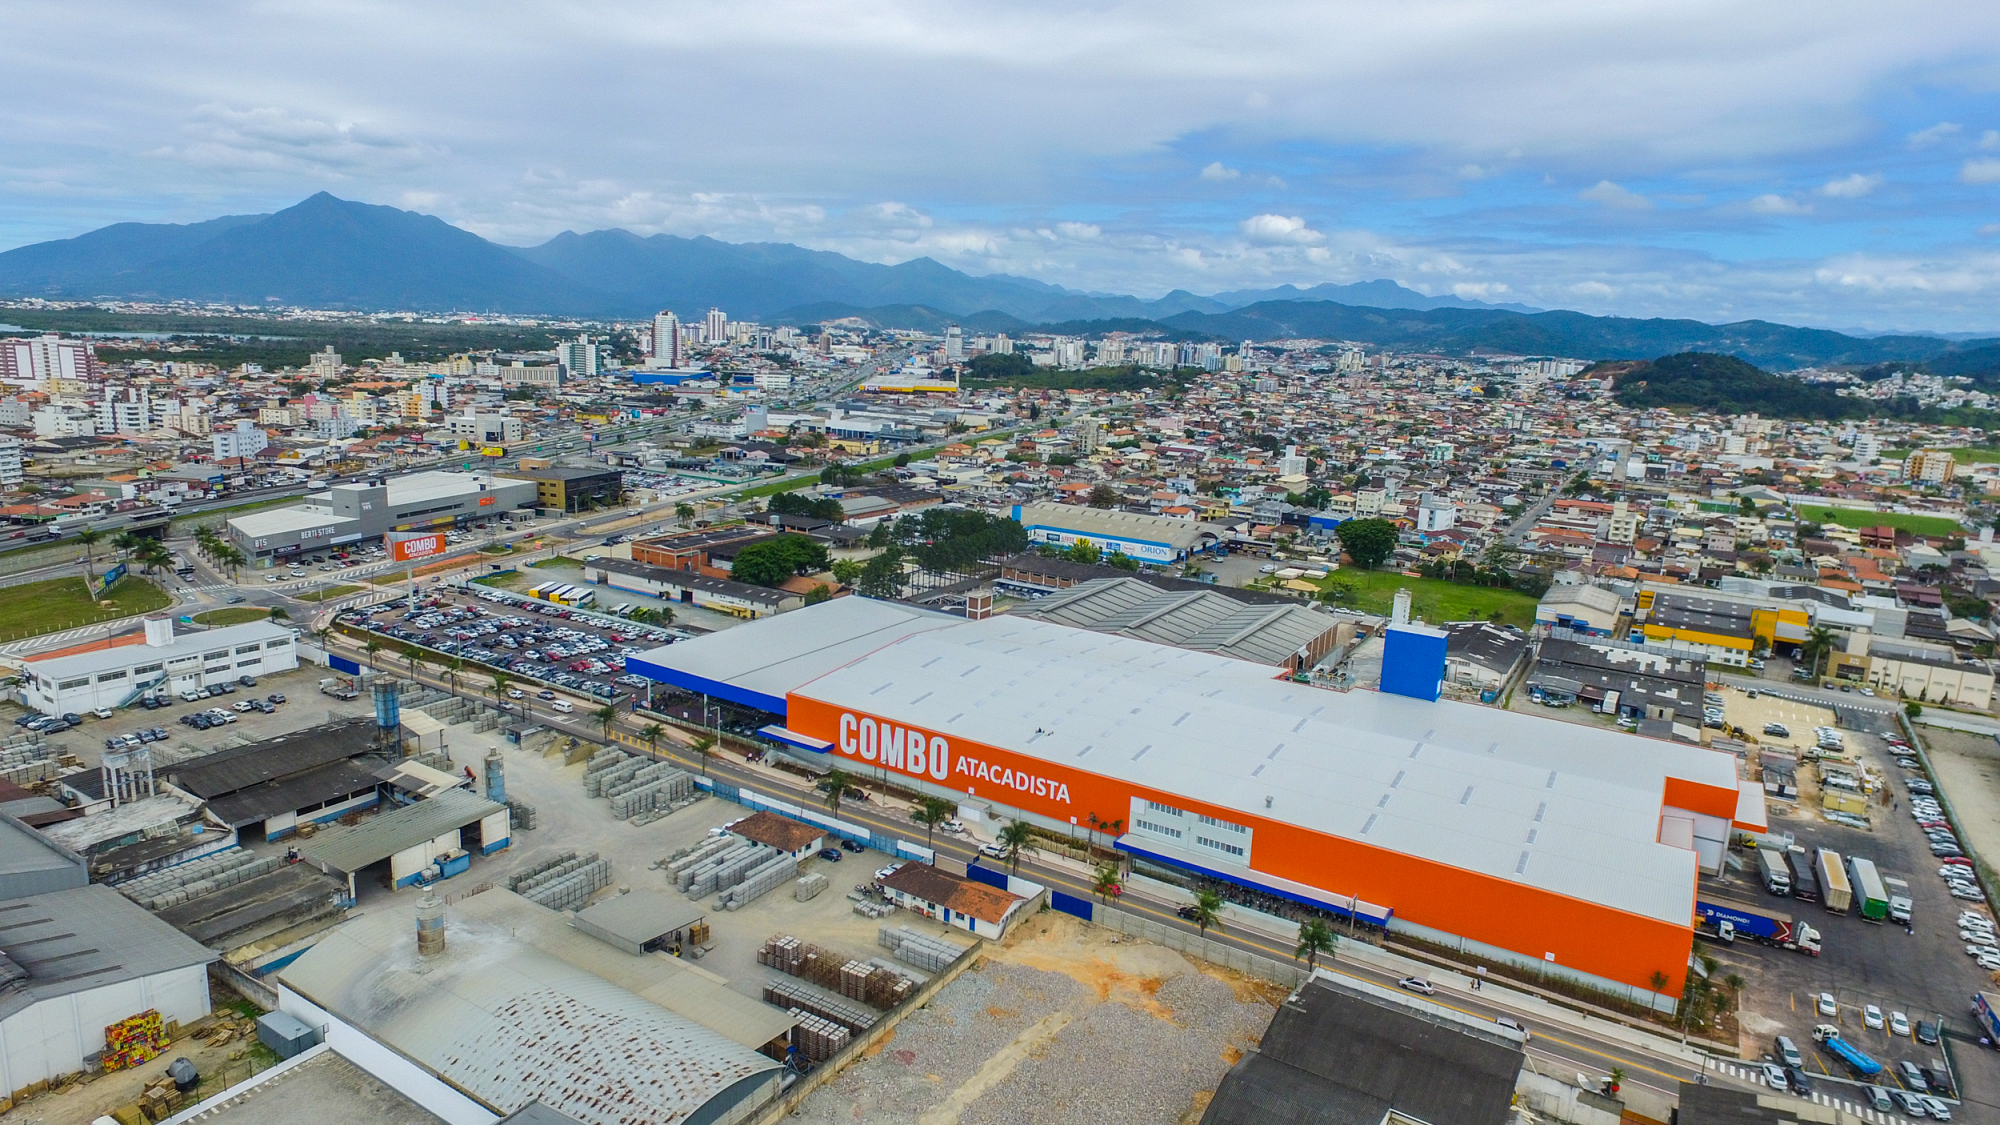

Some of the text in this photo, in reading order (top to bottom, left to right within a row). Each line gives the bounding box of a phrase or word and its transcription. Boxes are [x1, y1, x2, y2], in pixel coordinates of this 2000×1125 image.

[301, 526, 336, 539] BERTI STORE
[254, 538, 267, 548] BTS
[404, 537, 437, 554] COMBO
[1141, 545, 1167, 555] ORION
[839, 712, 1071, 804] COMBO ATACADISTA
[1716, 912, 1748, 924] DIAMOND
